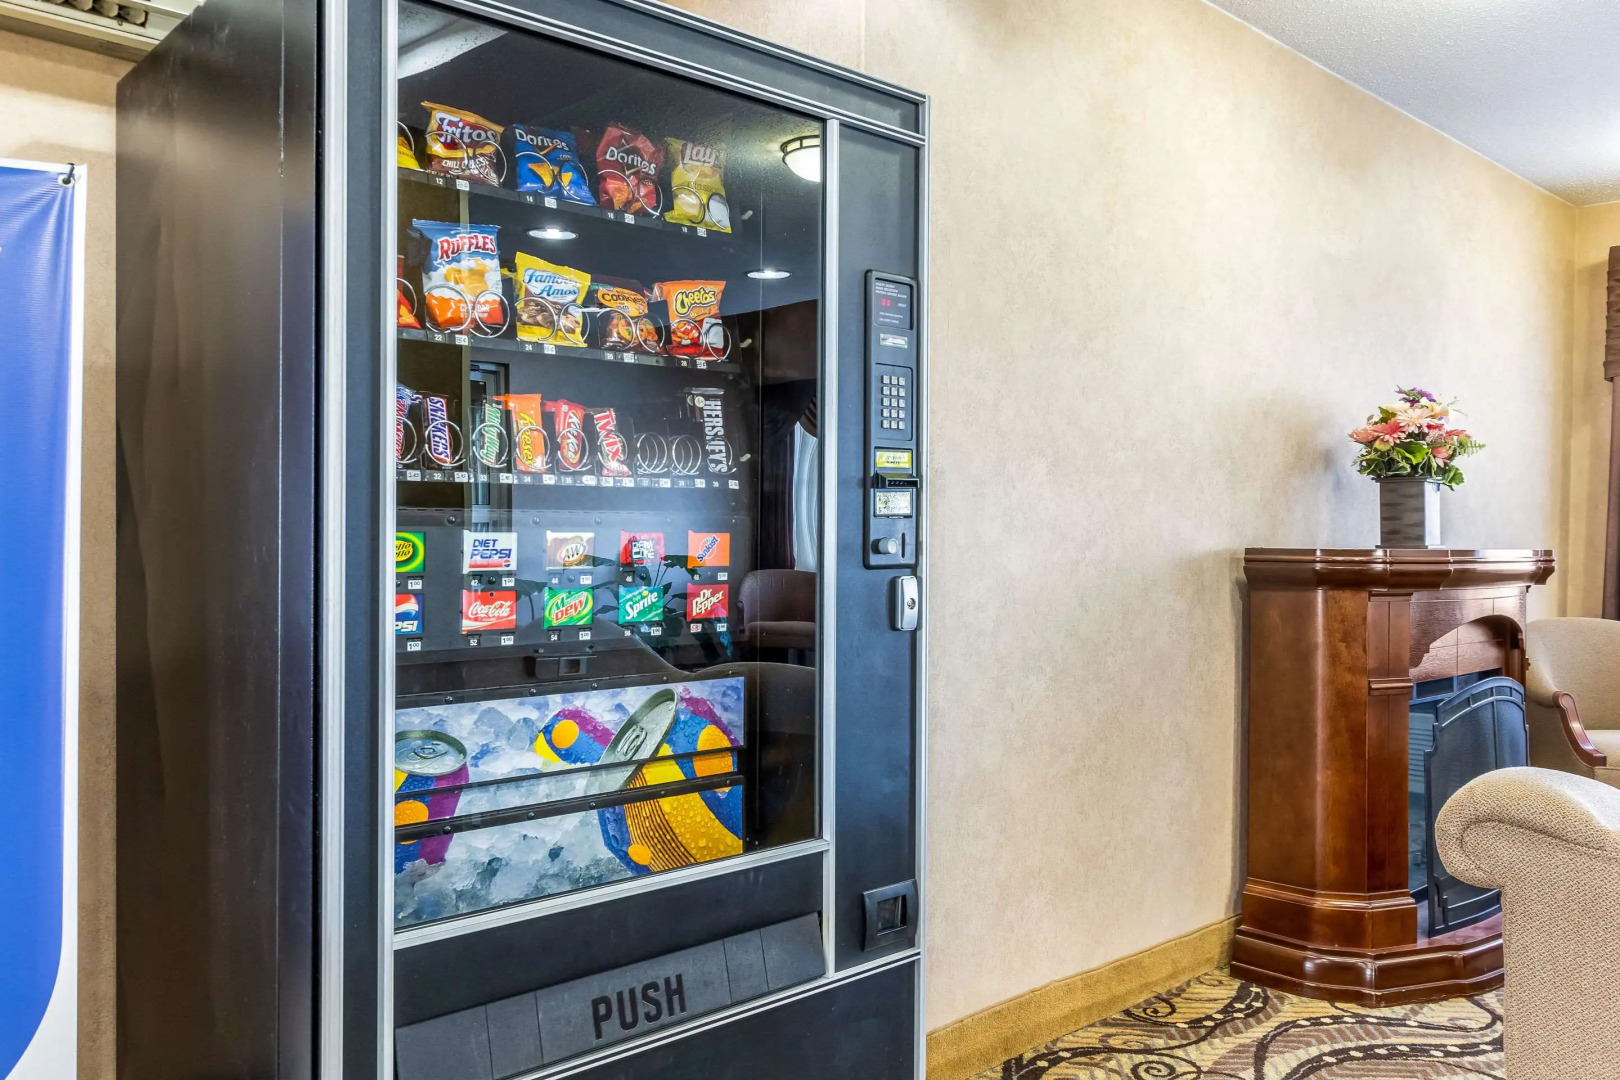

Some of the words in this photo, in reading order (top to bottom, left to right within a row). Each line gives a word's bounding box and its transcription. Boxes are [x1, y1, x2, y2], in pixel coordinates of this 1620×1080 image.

[435, 112, 496, 145] Fritos
[514, 128, 570, 151] Doritos
[605, 146, 657, 175] Doritos
[435, 177, 444, 185] 12
[437, 234, 497, 261] RUFFLES
[533, 284, 578, 297] Amos
[676, 287, 717, 315] Cheetos
[434, 334, 443, 342] 22
[428, 396, 450, 460] SNICKERS
[703, 400, 728, 473] HERSHEY'S
[433, 472, 442, 480] 32
[470, 549, 512, 559] PEPSI
[472, 539, 499, 548] DIET
[696, 536, 719, 562] Sunkist
[625, 592, 658, 620] Sprite
[692, 590, 724, 617] Pepper
[700, 589, 712, 600] Dr
[550, 634, 558, 642] 54
[591, 973, 687, 1040] PUSH
